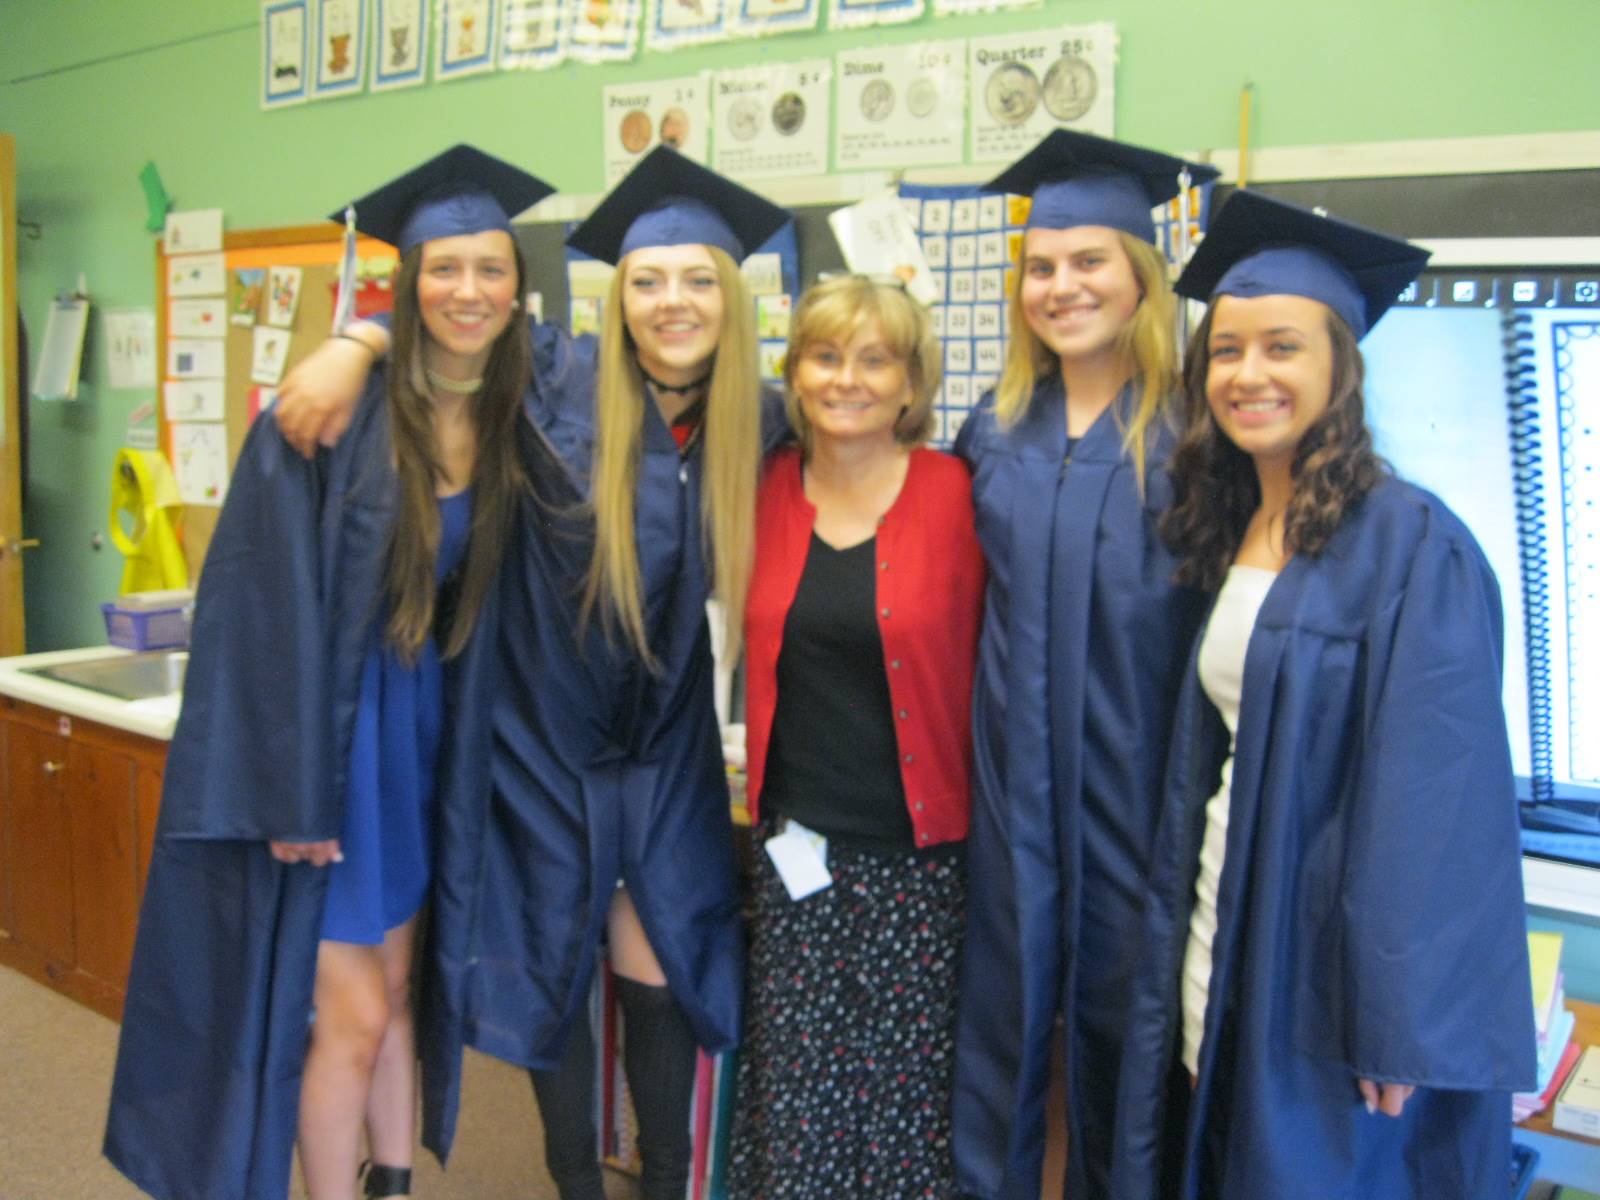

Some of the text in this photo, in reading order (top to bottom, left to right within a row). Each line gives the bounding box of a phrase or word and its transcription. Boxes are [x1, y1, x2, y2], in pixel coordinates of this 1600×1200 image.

[976, 46, 1047, 66] Quarter
[1060, 39, 1083, 56] 25
[844, 62, 885, 76] Dime
[919, 53, 936, 69] 10
[609, 95, 650, 108] Penny
[979, 313, 996, 327] 34
